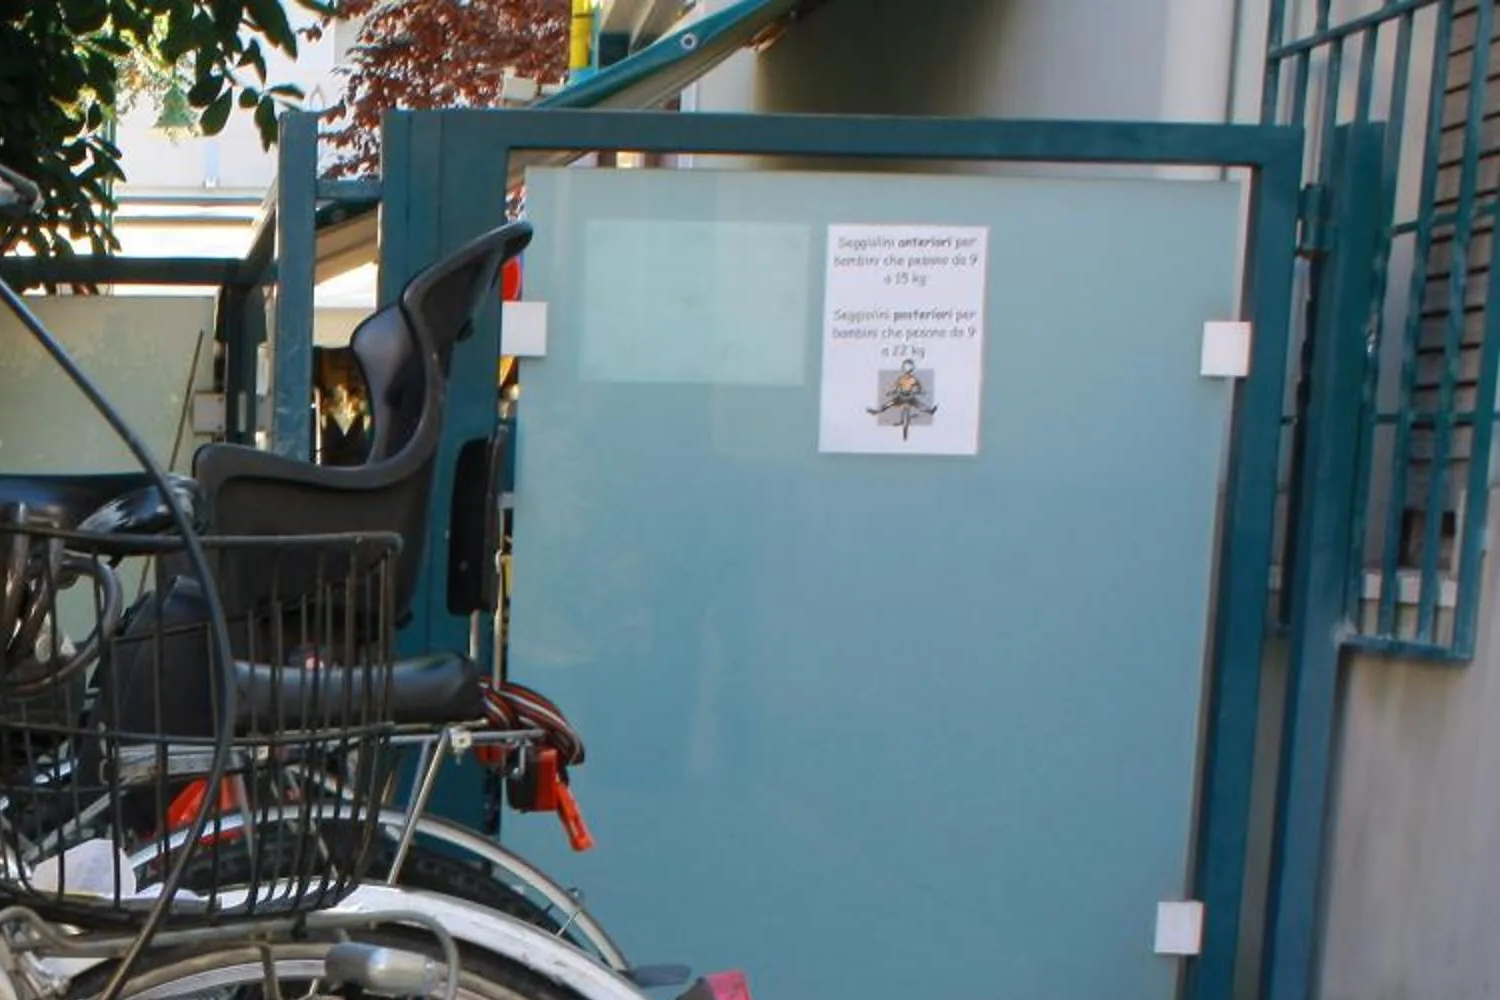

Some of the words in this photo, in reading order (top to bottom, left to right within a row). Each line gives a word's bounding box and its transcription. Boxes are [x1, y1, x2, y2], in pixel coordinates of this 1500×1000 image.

[838, 237, 894, 250] Seggiolini
[898, 237, 951, 247] anteriori
[955, 238, 977, 250] per
[883, 255, 905, 266] che
[907, 257, 949, 268] pesano
[951, 255, 966, 266] da
[969, 254, 978, 266] 9
[895, 272, 909, 285] 15
[912, 273, 927, 287] kg
[833, 308, 889, 323] Seggiolini
[893, 308, 953, 321] posteriori
[955, 310, 976, 322] per
[832, 328, 878, 339] bambini
[881, 326, 902, 337] che
[906, 328, 948, 340] pesano
[949, 327, 964, 337] da
[968, 326, 976, 337] 9
[892, 345, 908, 357] 22
[911, 346, 925, 359] kg
